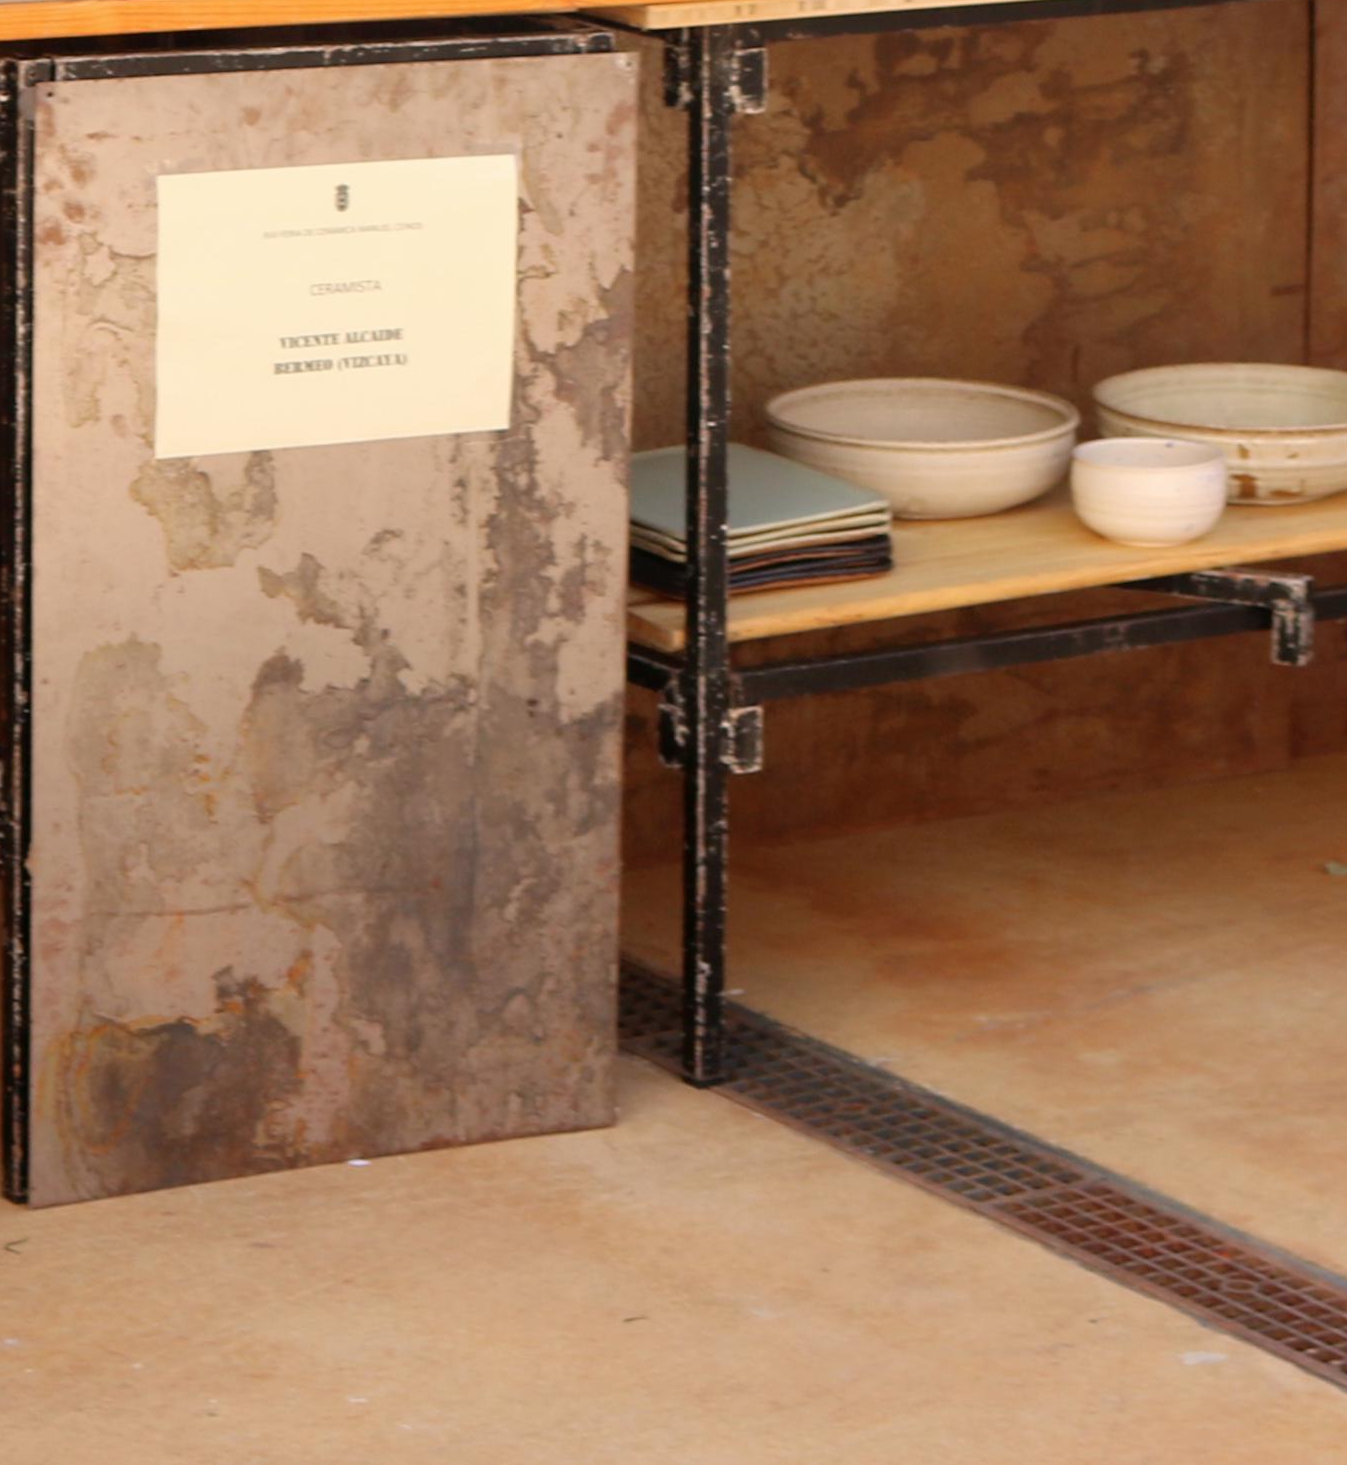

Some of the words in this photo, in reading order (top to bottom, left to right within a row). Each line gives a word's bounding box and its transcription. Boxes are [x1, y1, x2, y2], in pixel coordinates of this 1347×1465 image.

[309, 279, 382, 296] CERAMISTA
[279, 332, 340, 349] VICENTE
[273, 359, 333, 375] BERMEO
